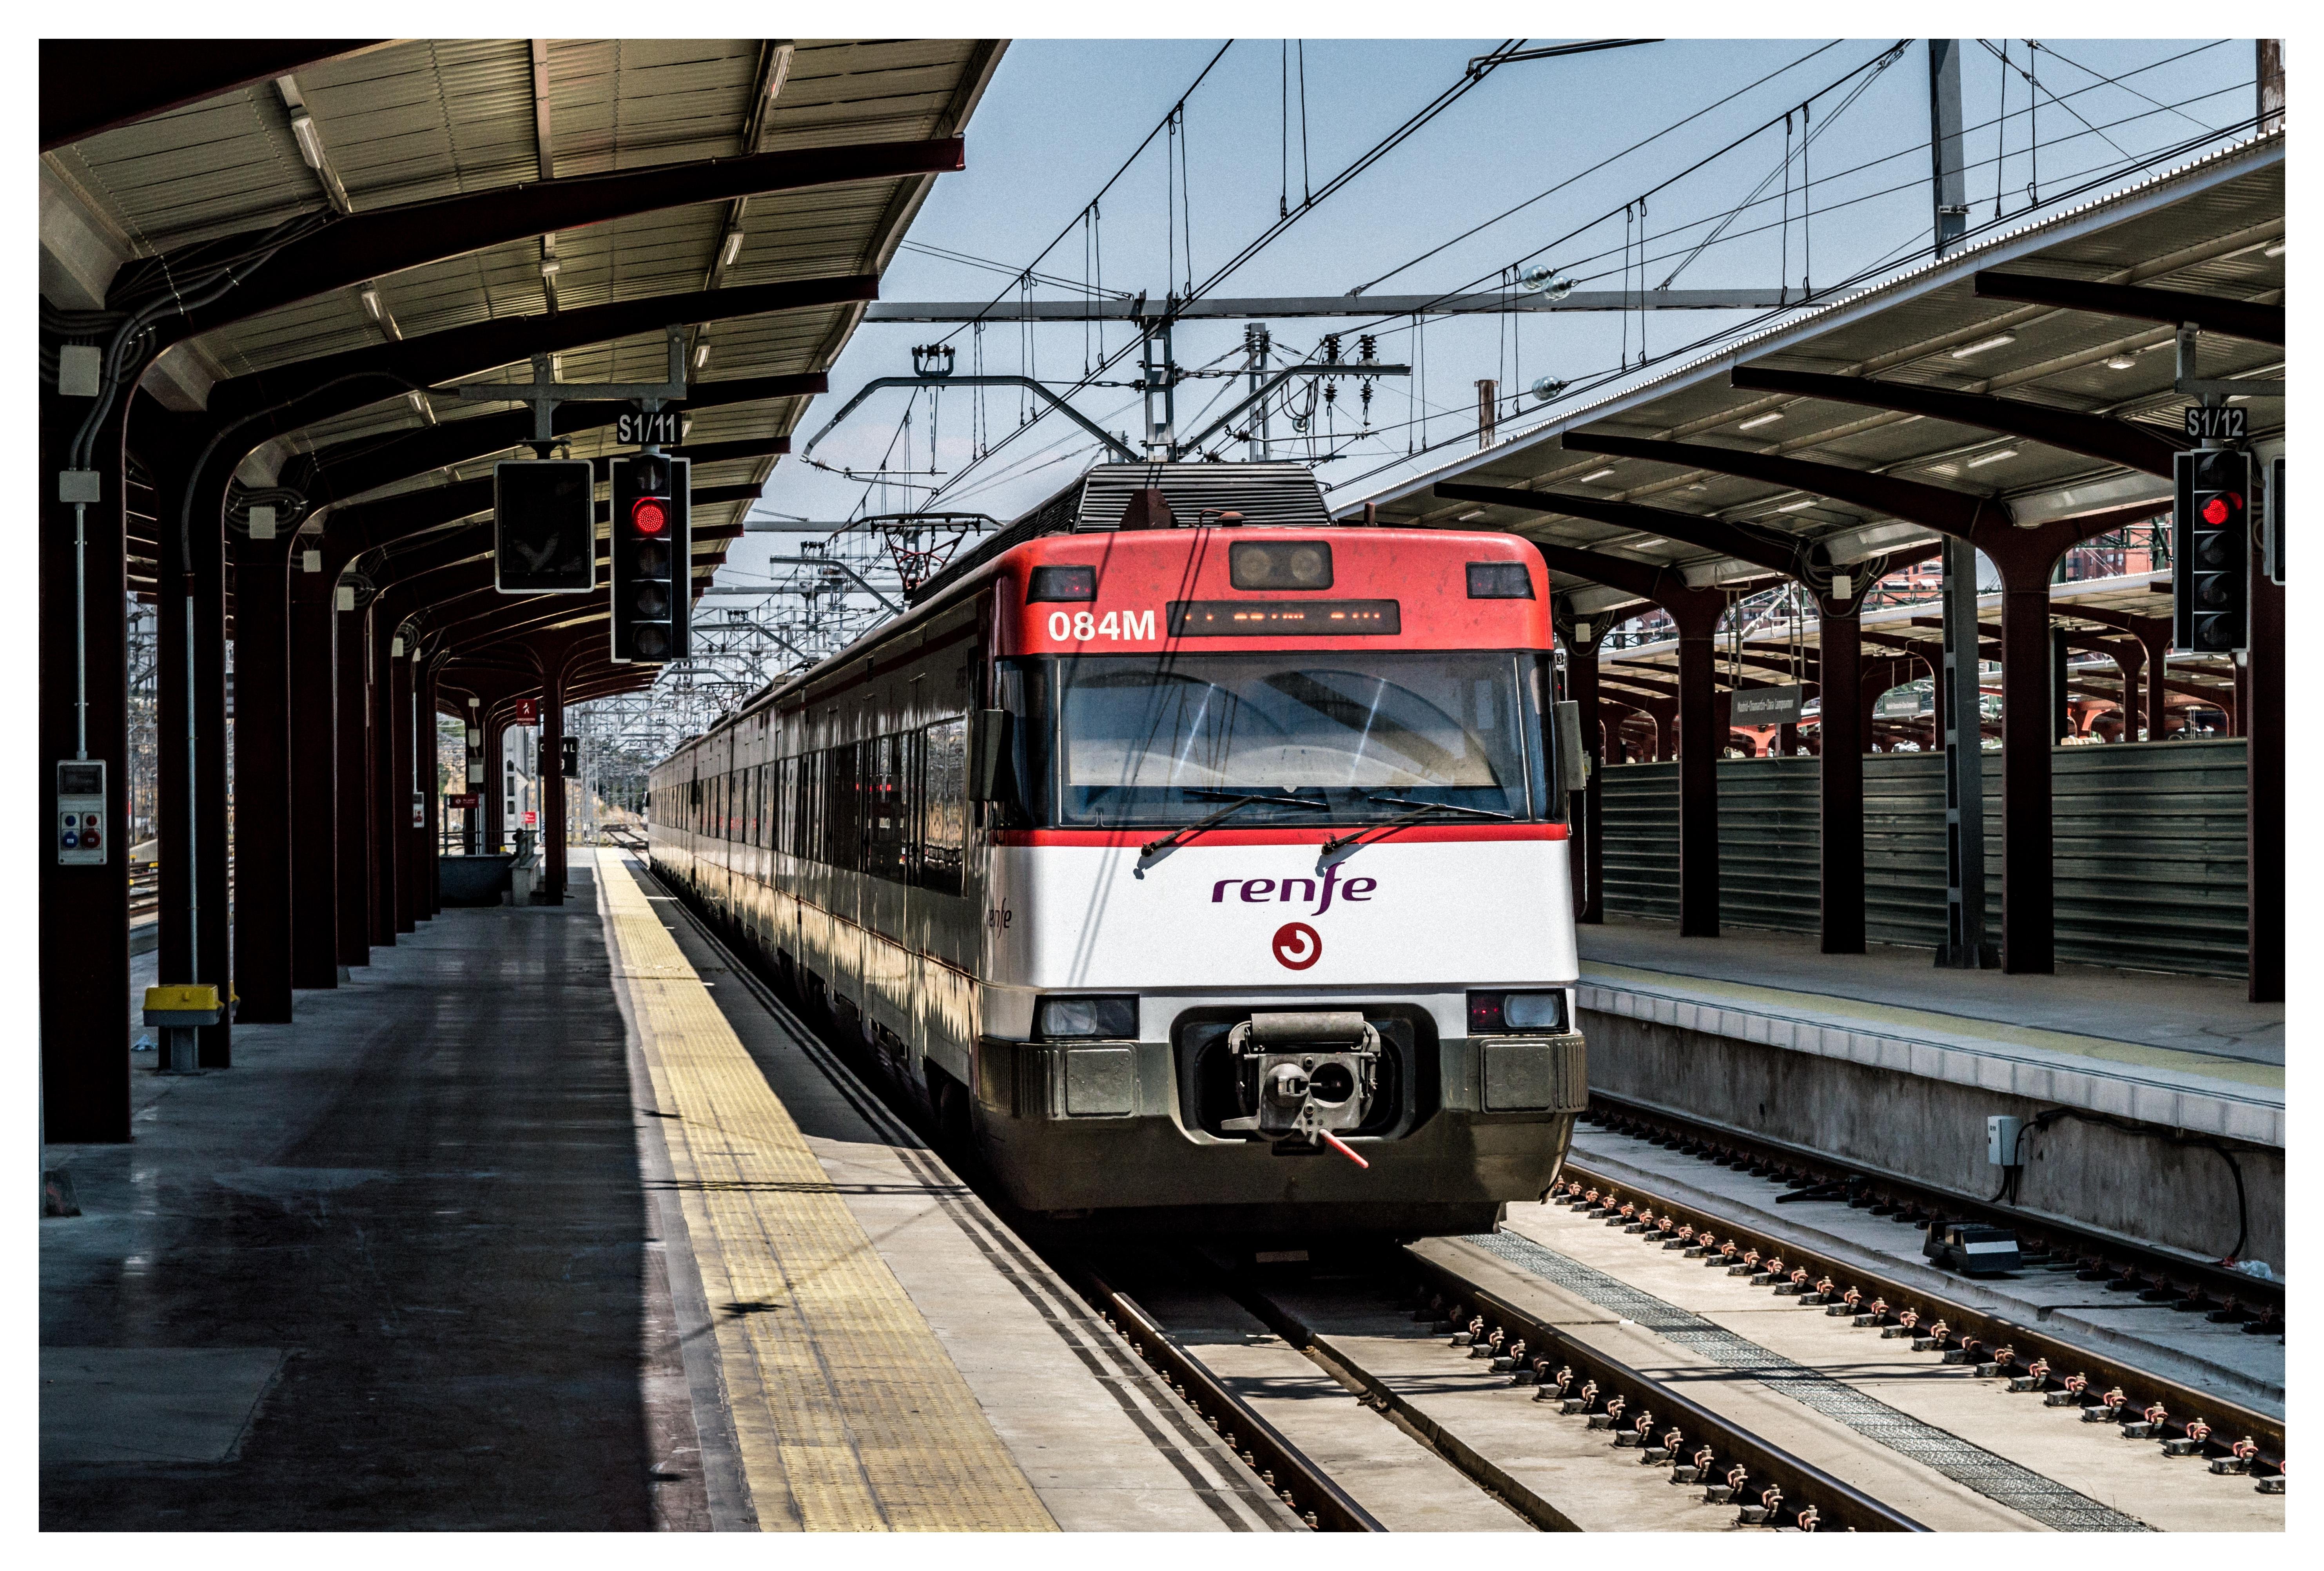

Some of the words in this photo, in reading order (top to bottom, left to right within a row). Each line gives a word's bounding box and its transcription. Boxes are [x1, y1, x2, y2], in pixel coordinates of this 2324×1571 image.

[619, 414, 675, 442] S1/11
[2188, 409, 2243, 436] S1/12
[1048, 610, 1156, 641] 084M
[1212, 861, 1377, 917] renfe
